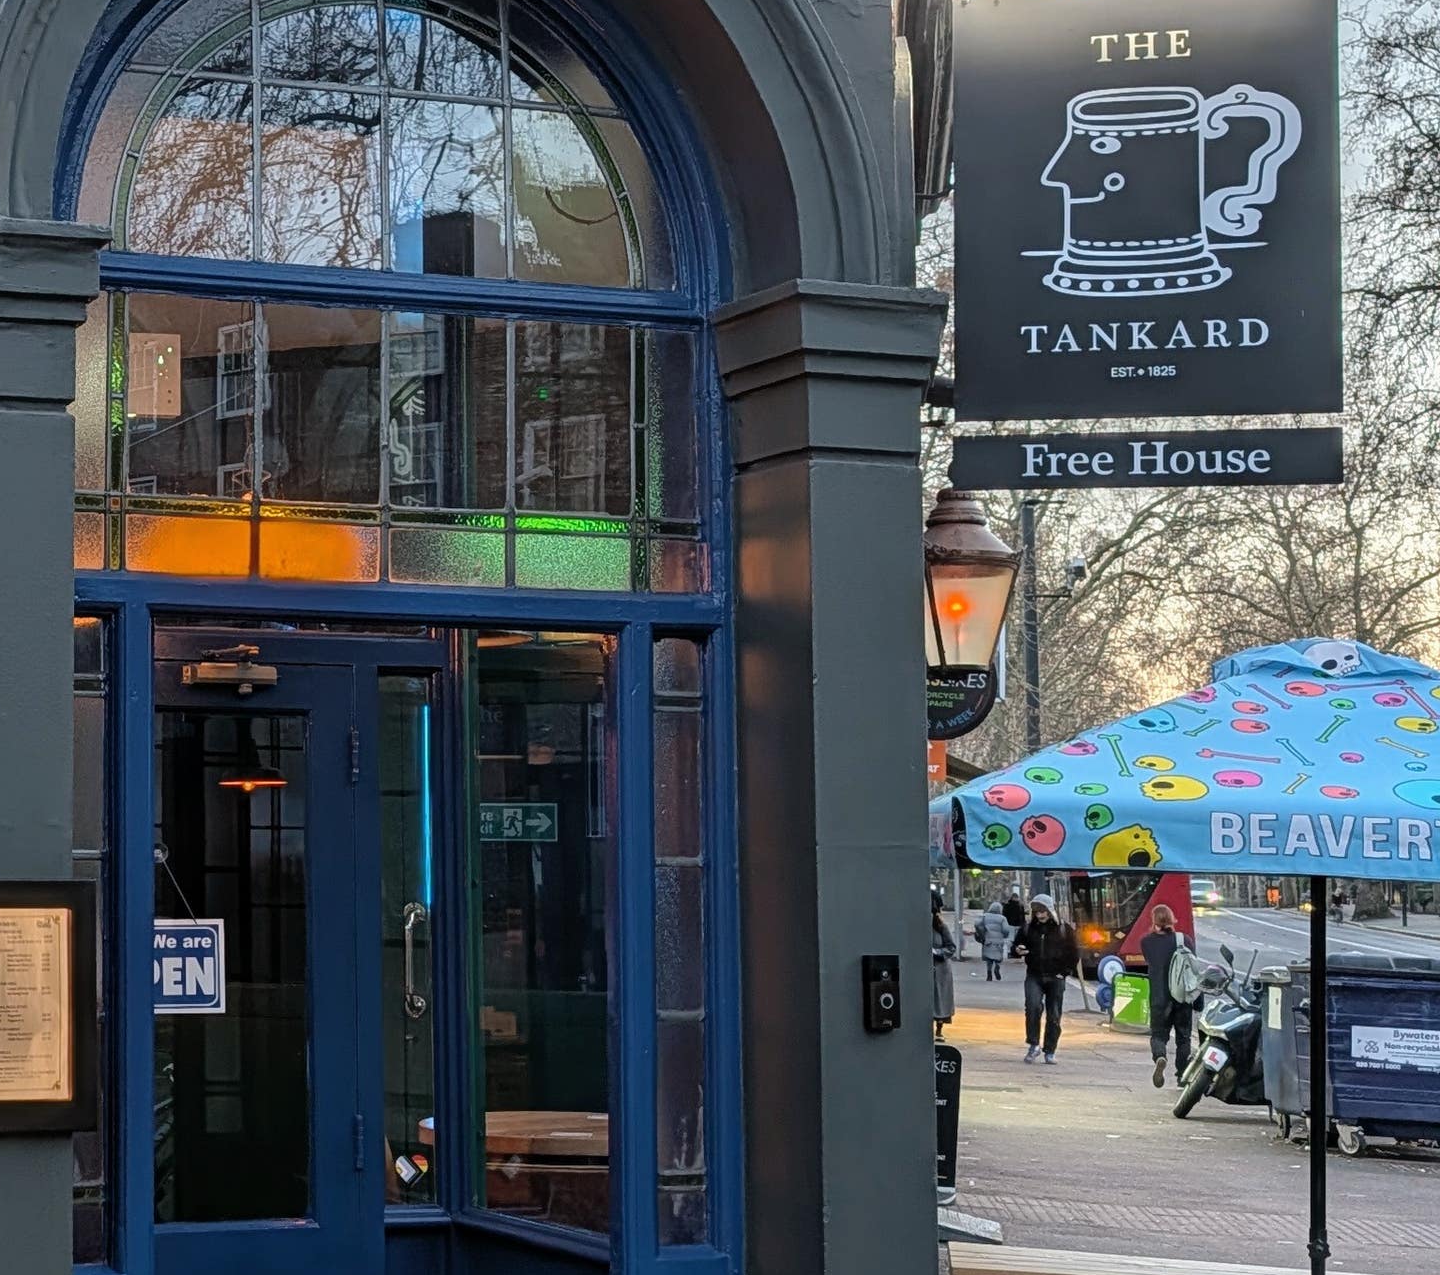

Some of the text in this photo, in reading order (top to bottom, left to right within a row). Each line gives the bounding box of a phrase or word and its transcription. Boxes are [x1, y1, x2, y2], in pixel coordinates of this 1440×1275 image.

[1090, 29, 1192, 63] THE
[1020, 318, 1270, 354] TANKARD
[1148, 365, 1176, 377] 1825
[1021, 441, 1271, 477] Free House
[1210, 811, 1440, 861] BEAVER
[183, 936, 212, 949] are
[1393, 1029, 1440, 1041] Bywaters
